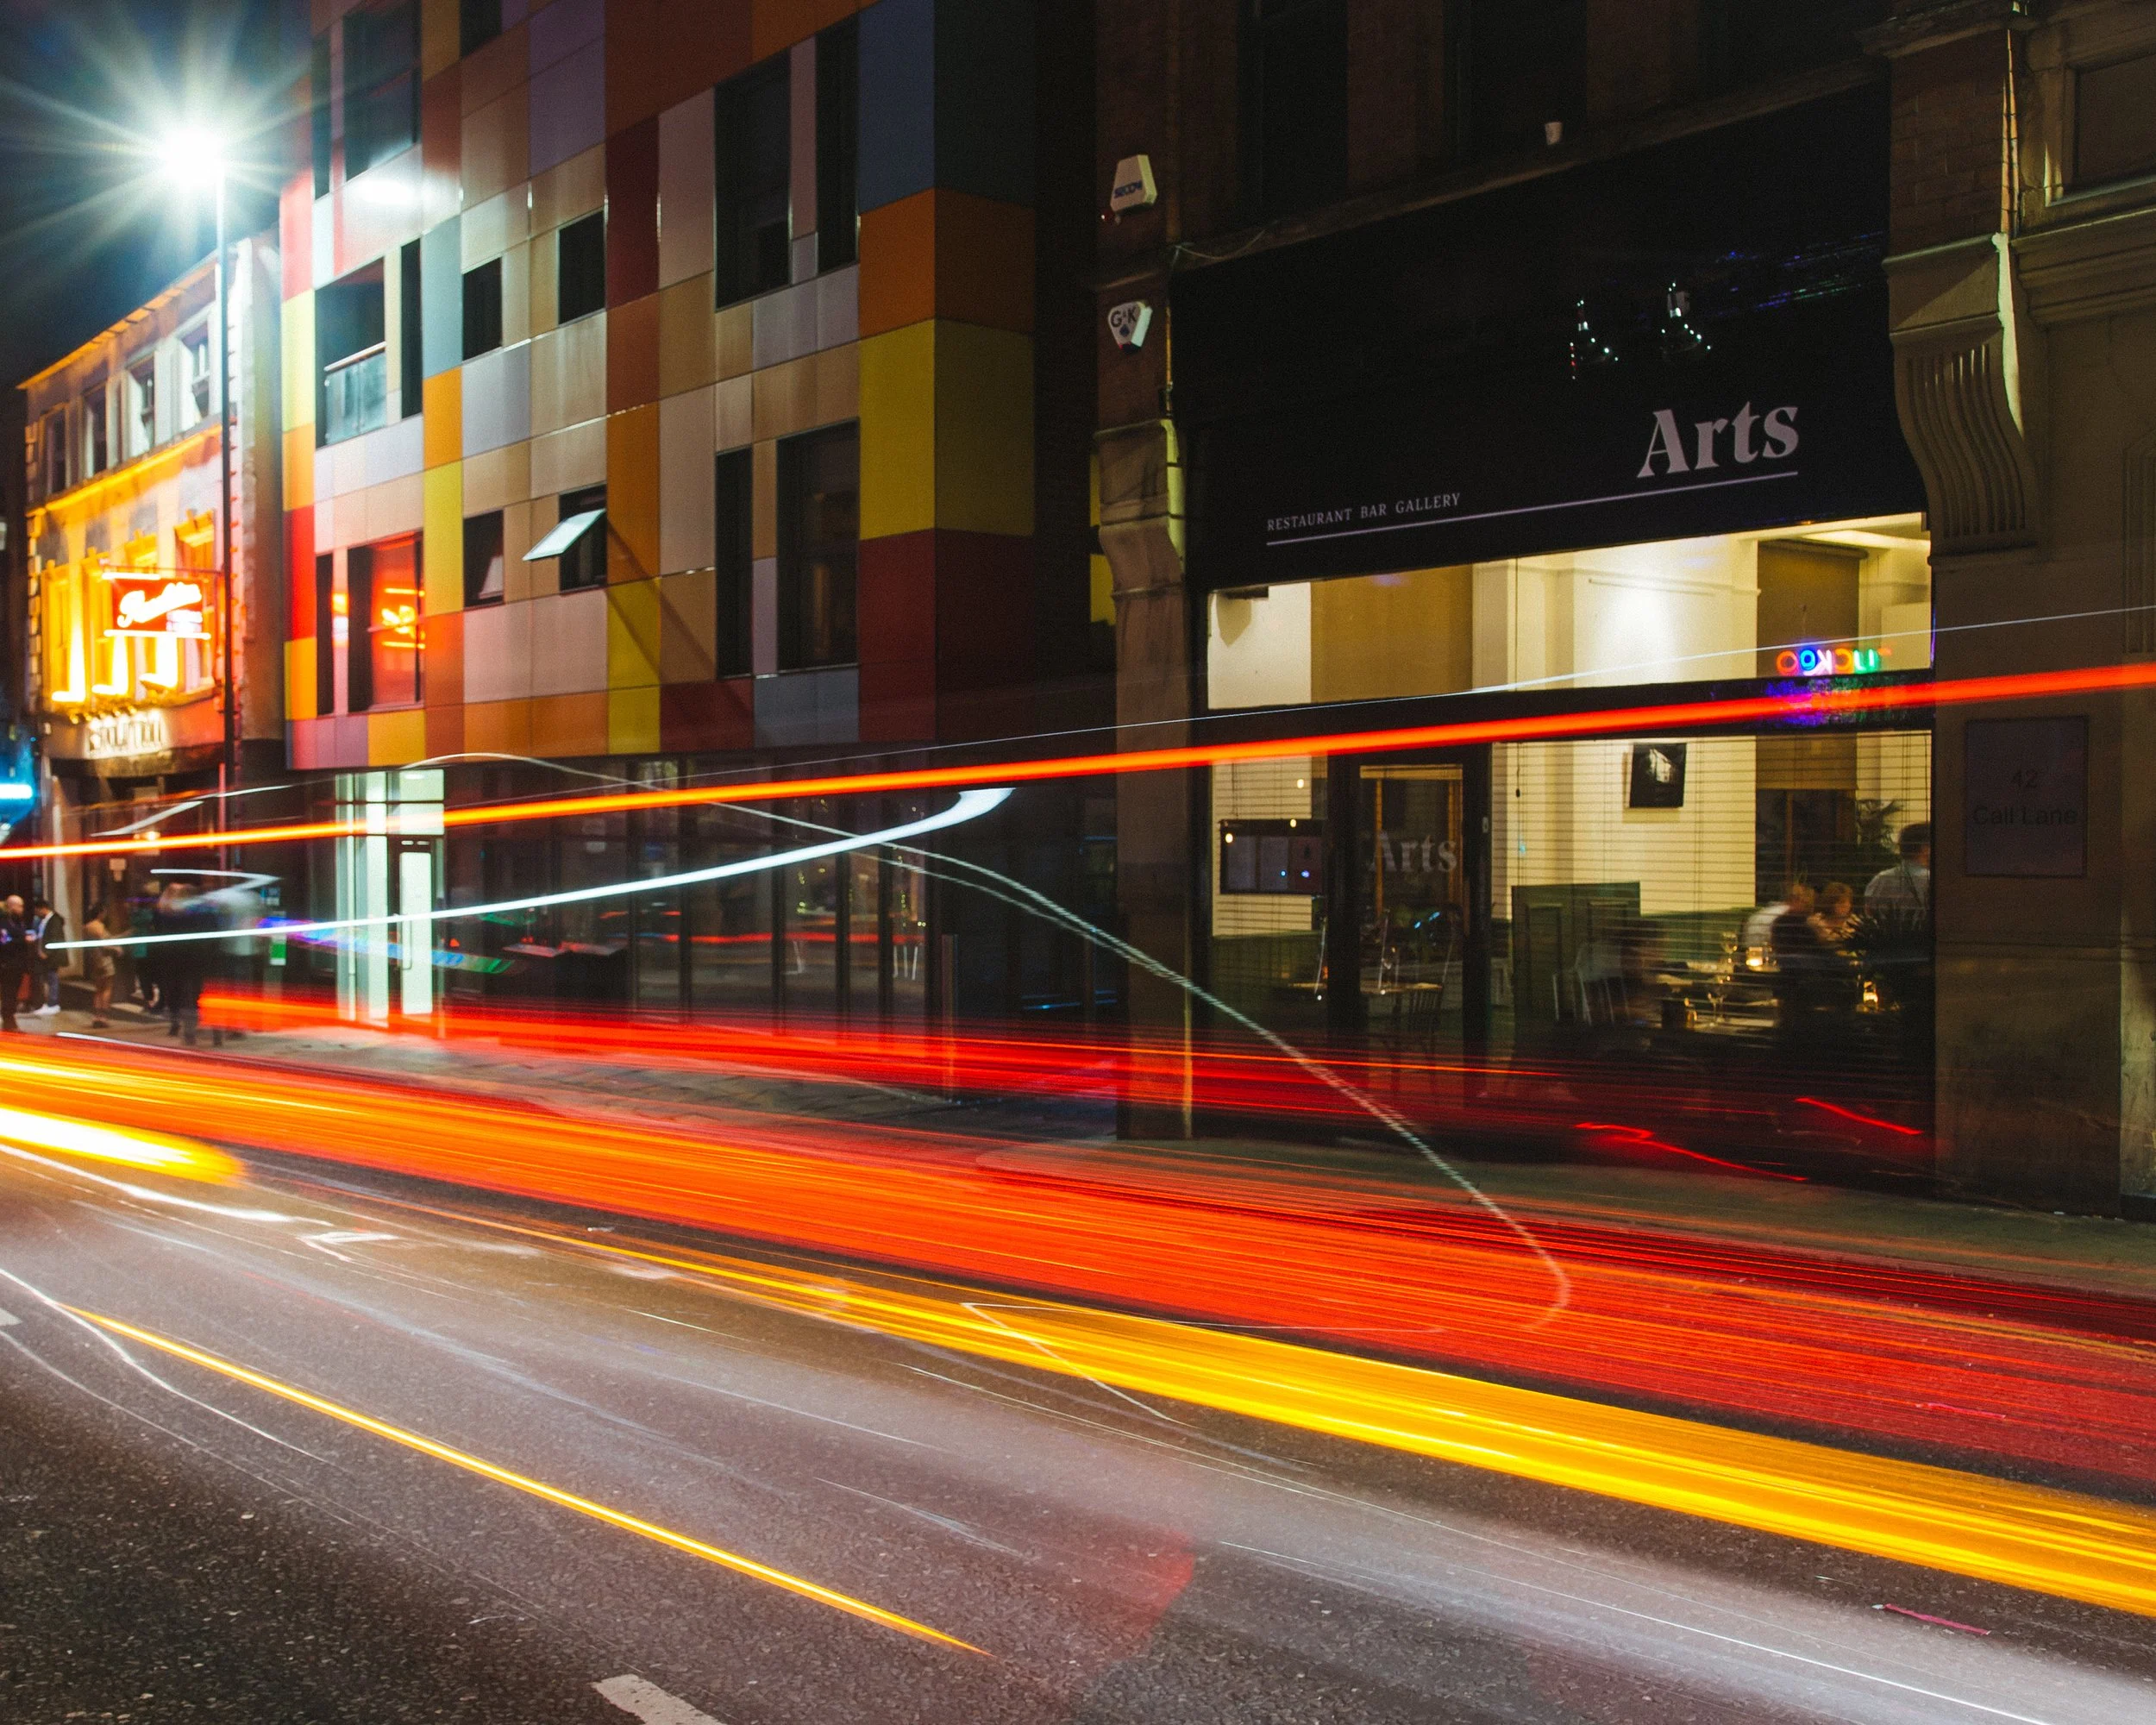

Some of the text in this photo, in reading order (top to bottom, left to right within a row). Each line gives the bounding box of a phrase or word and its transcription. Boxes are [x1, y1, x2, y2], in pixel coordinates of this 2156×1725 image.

[1637, 401, 1800, 478] Arts
[1267, 492, 1461, 531] RESTAURANT BAR GALLERY
[2010, 768, 2039, 788] 42
[1972, 805, 2078, 825] Call Lane
[1369, 831, 1458, 873] Arts
